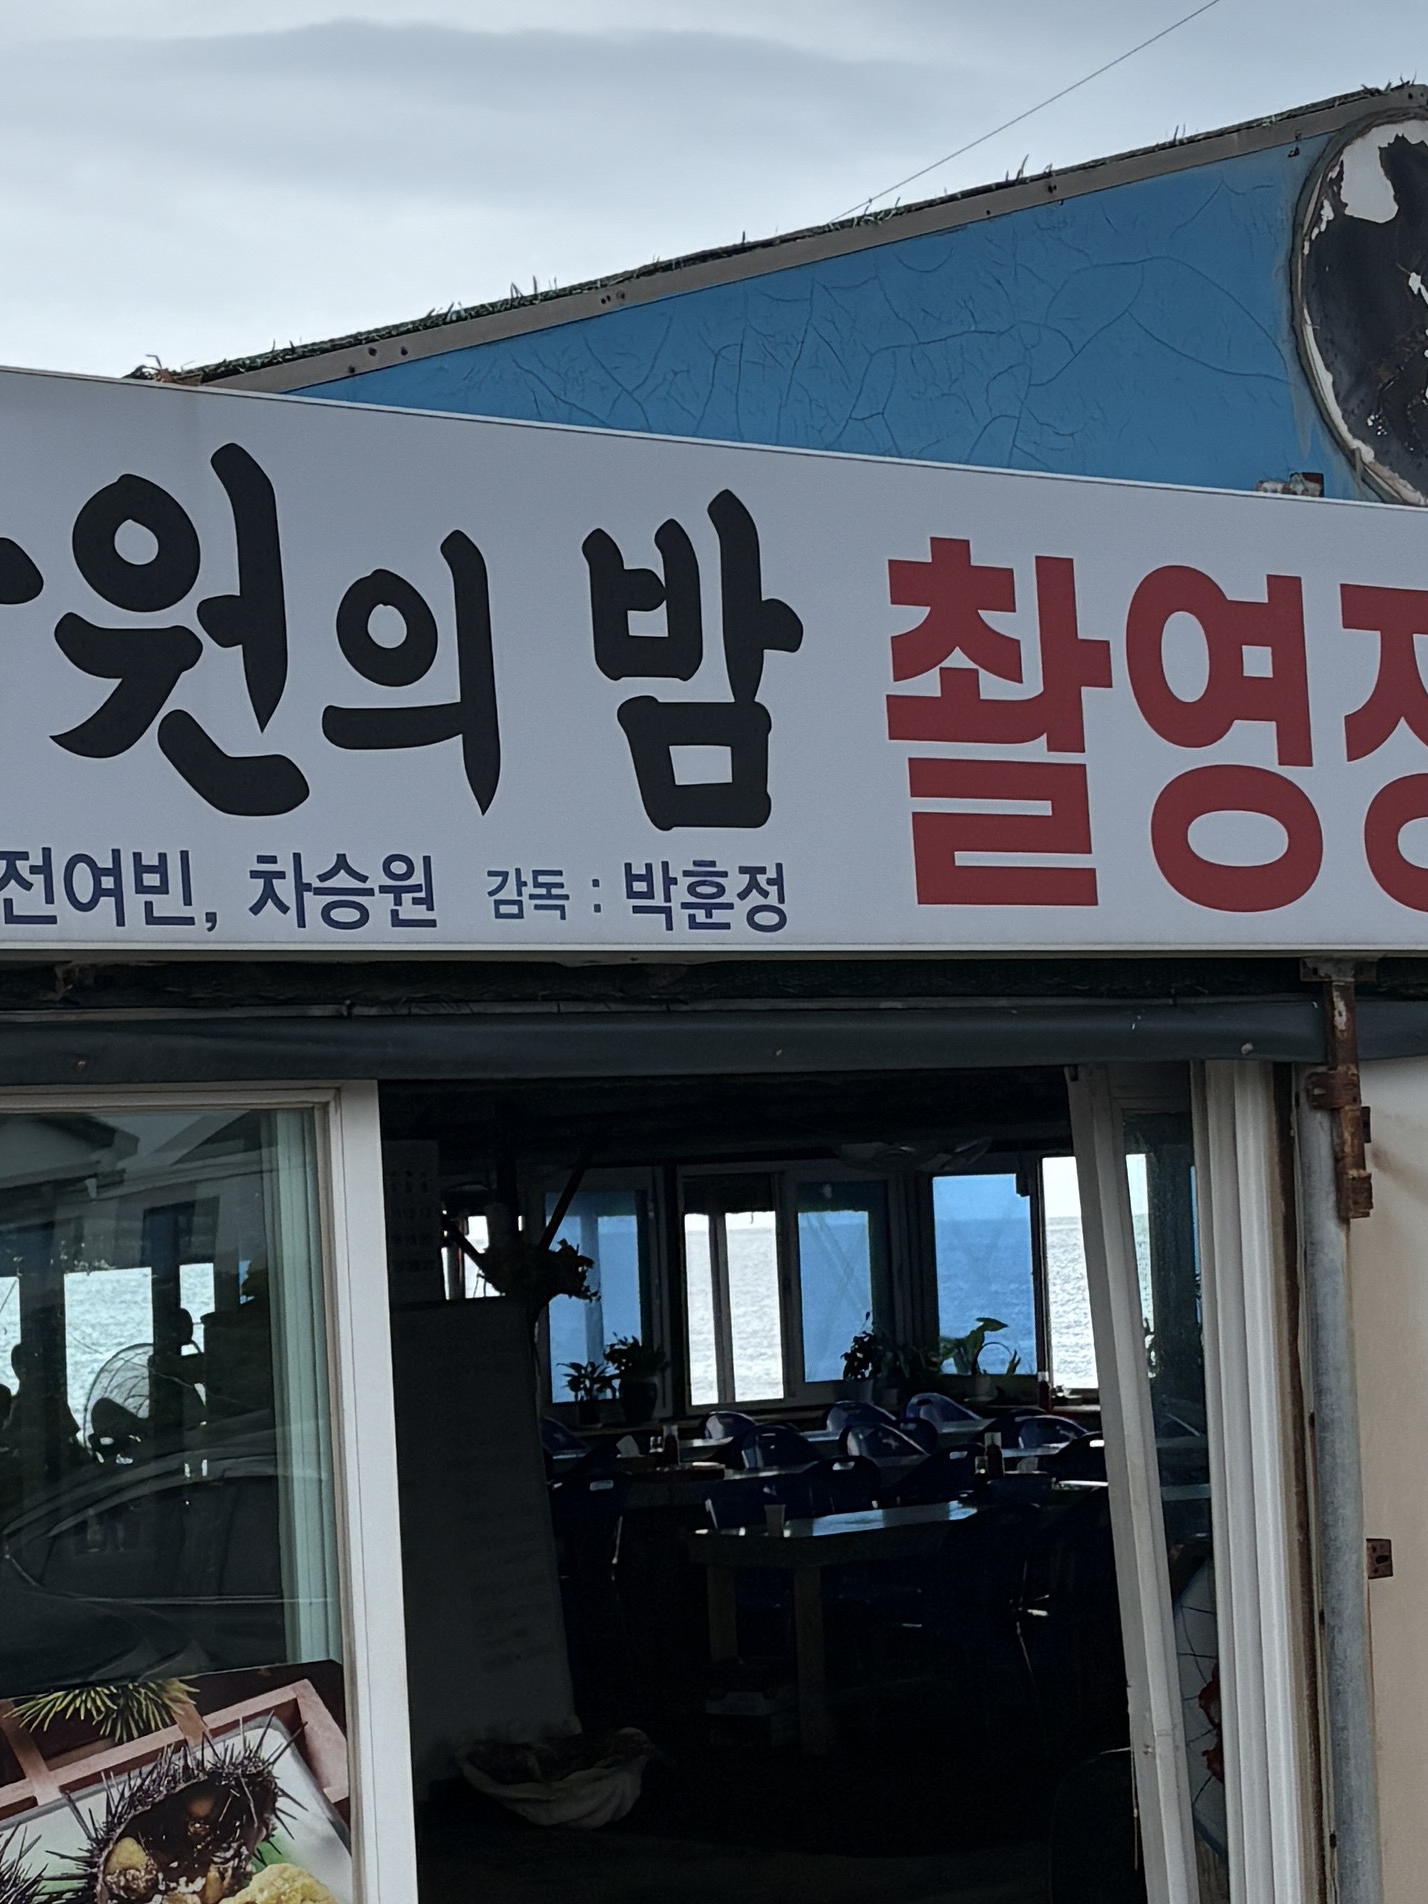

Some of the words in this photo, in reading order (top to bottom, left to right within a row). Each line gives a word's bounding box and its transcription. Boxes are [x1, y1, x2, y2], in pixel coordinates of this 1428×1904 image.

[582, 489, 803, 830] 밤
[247, 851, 438, 930] 차승원
[486, 866, 570, 921] 감독
[624, 859, 788, 934] 박훈정
